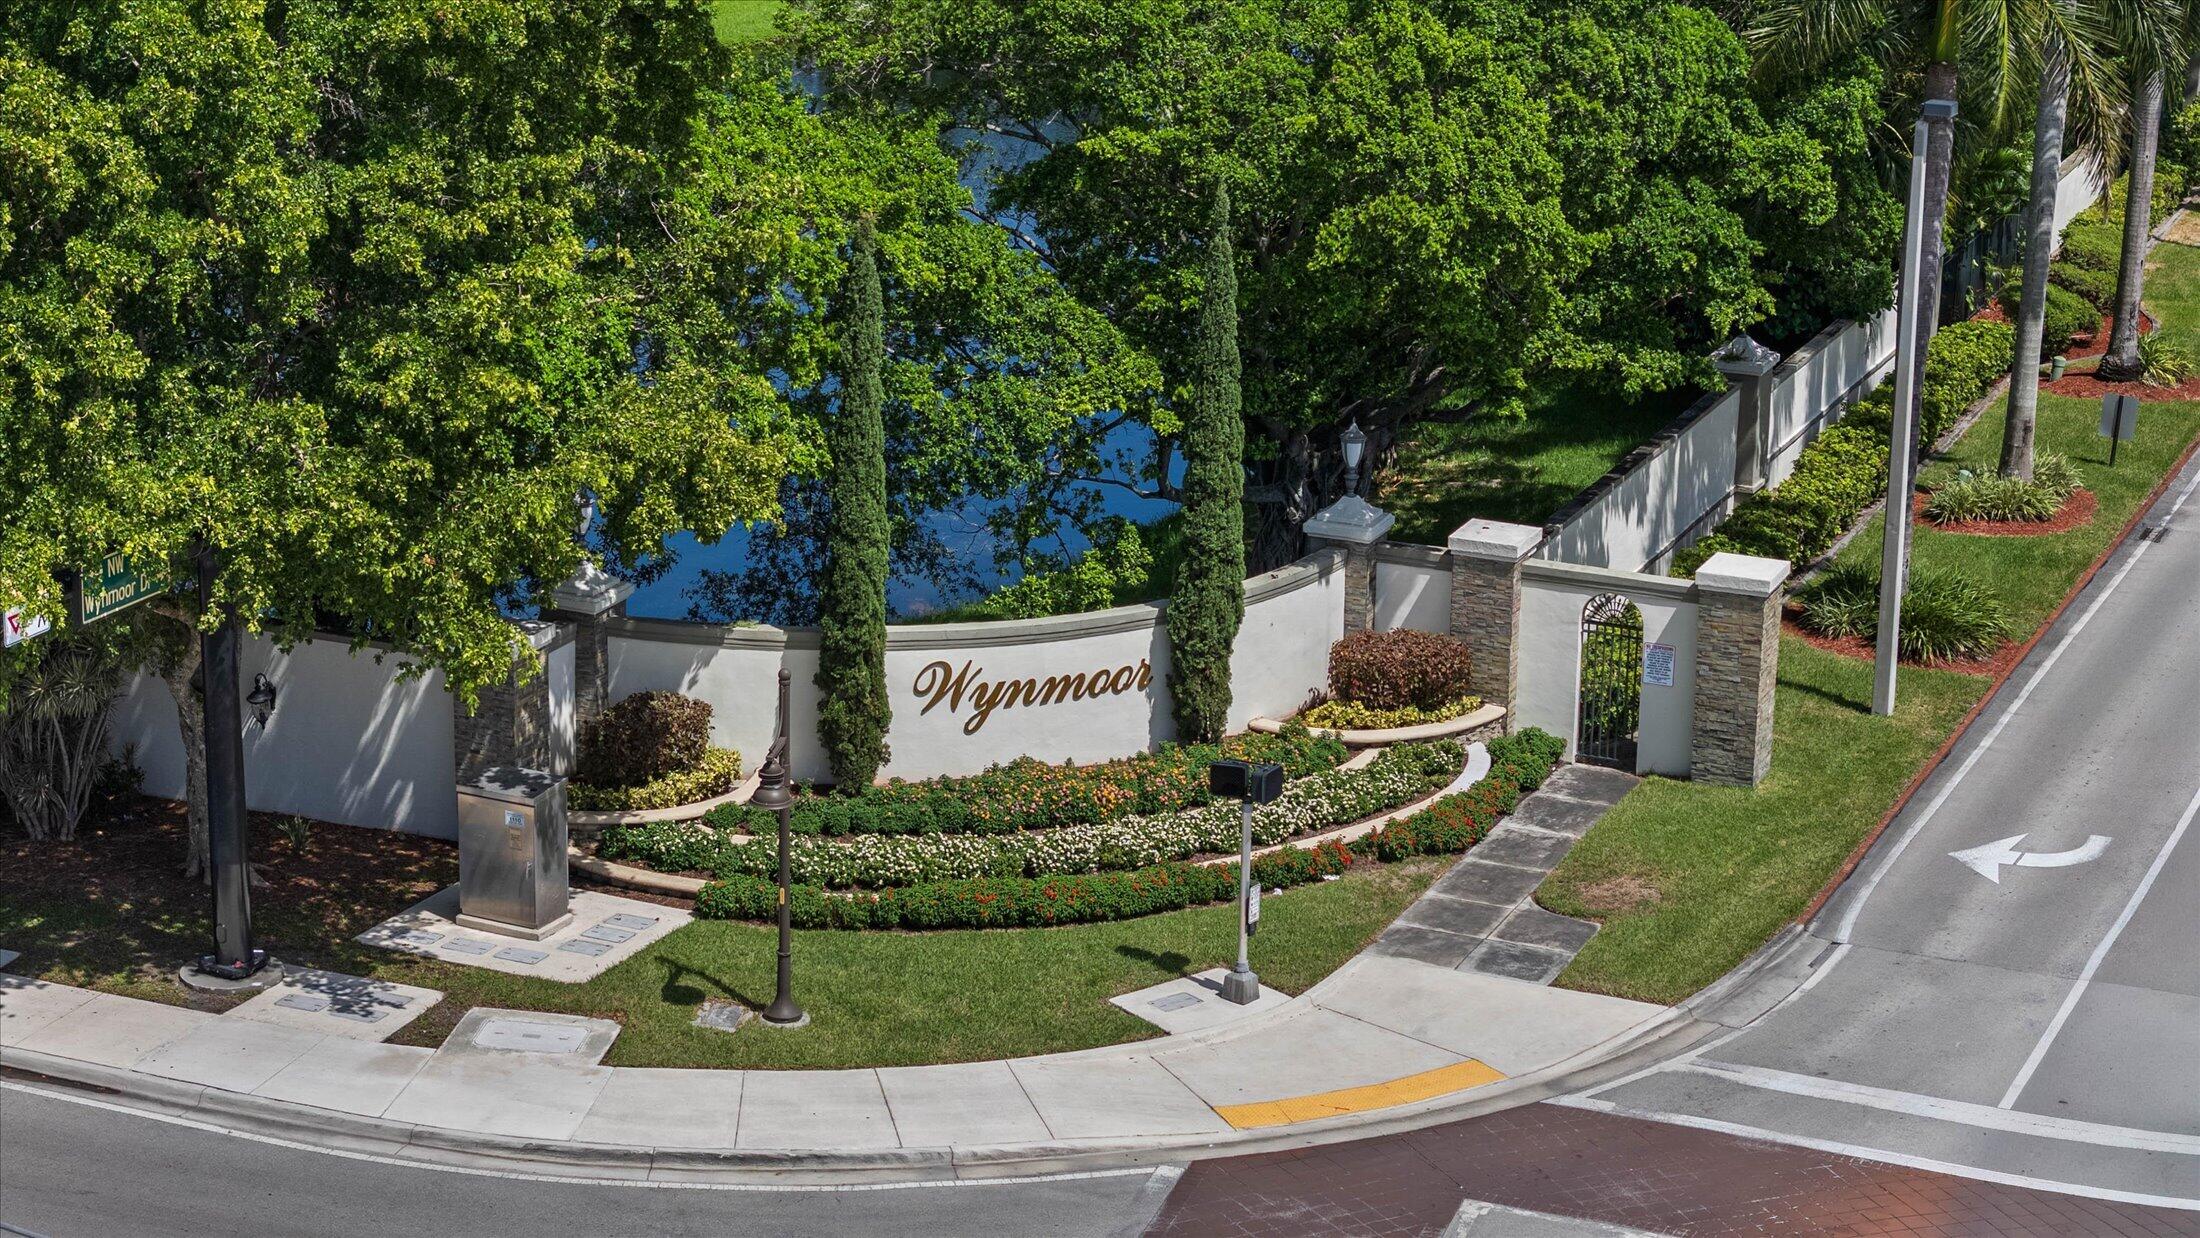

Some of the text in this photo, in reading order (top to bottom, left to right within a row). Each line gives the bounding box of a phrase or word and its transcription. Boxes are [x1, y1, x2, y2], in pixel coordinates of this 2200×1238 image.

[107, 554, 124, 577] NW
[84, 582, 136, 615] Wynmoor
[913, 658, 1153, 736] Wynmoor
